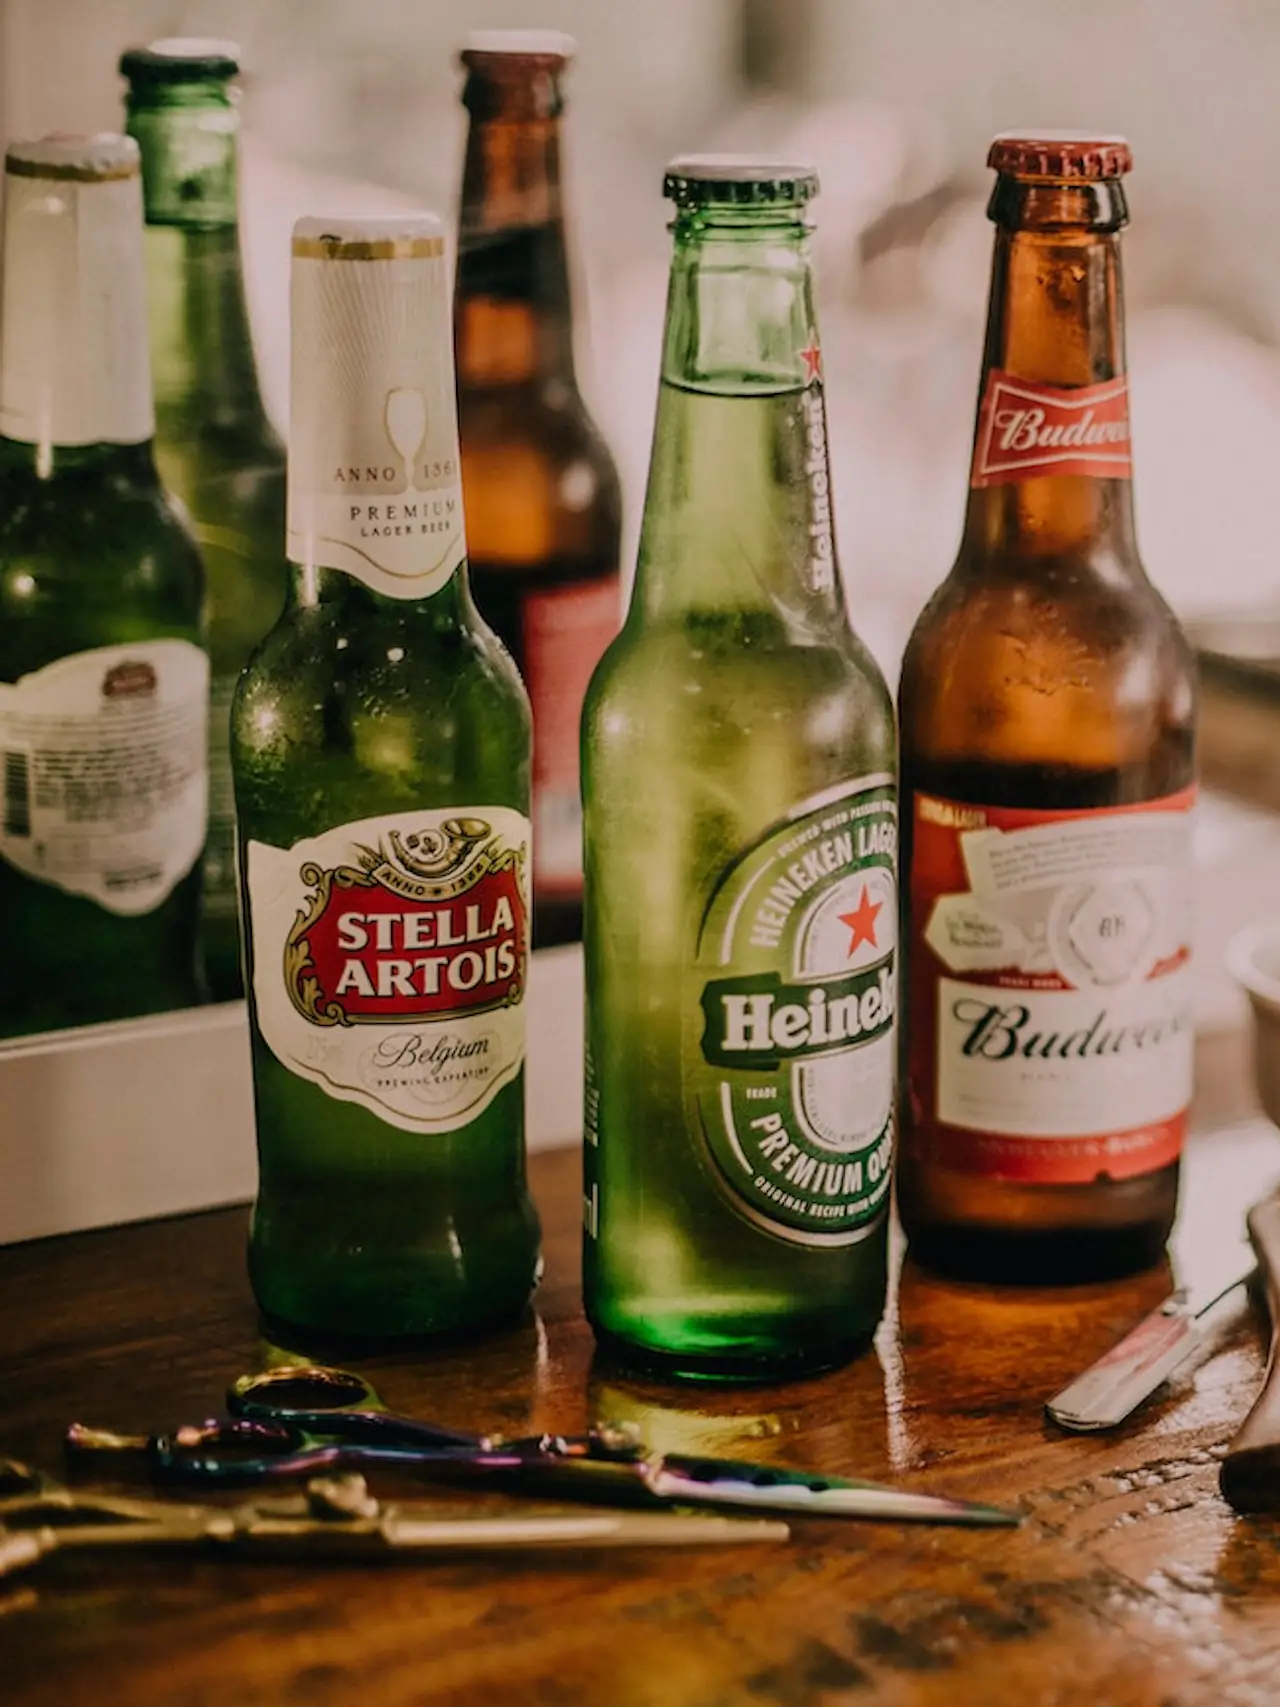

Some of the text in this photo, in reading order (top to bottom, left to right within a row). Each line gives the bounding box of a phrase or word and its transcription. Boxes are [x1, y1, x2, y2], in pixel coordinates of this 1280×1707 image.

[334, 466, 396, 482] ANNO
[350, 499, 456, 521] PREMIUM
[360, 525, 413, 538] LAGER
[381, 871, 425, 895] ANNO
[749, 831, 854, 949] HEINEKEN
[337, 895, 515, 951] STELLA
[336, 939, 515, 997] ARTOIS
[373, 1032, 489, 1076] Belgium
[751, 1112, 863, 1196] PREMIUM
[754, 1175, 807, 1213] ORIGINAL
[809, 1204, 845, 1218] RECIPE
